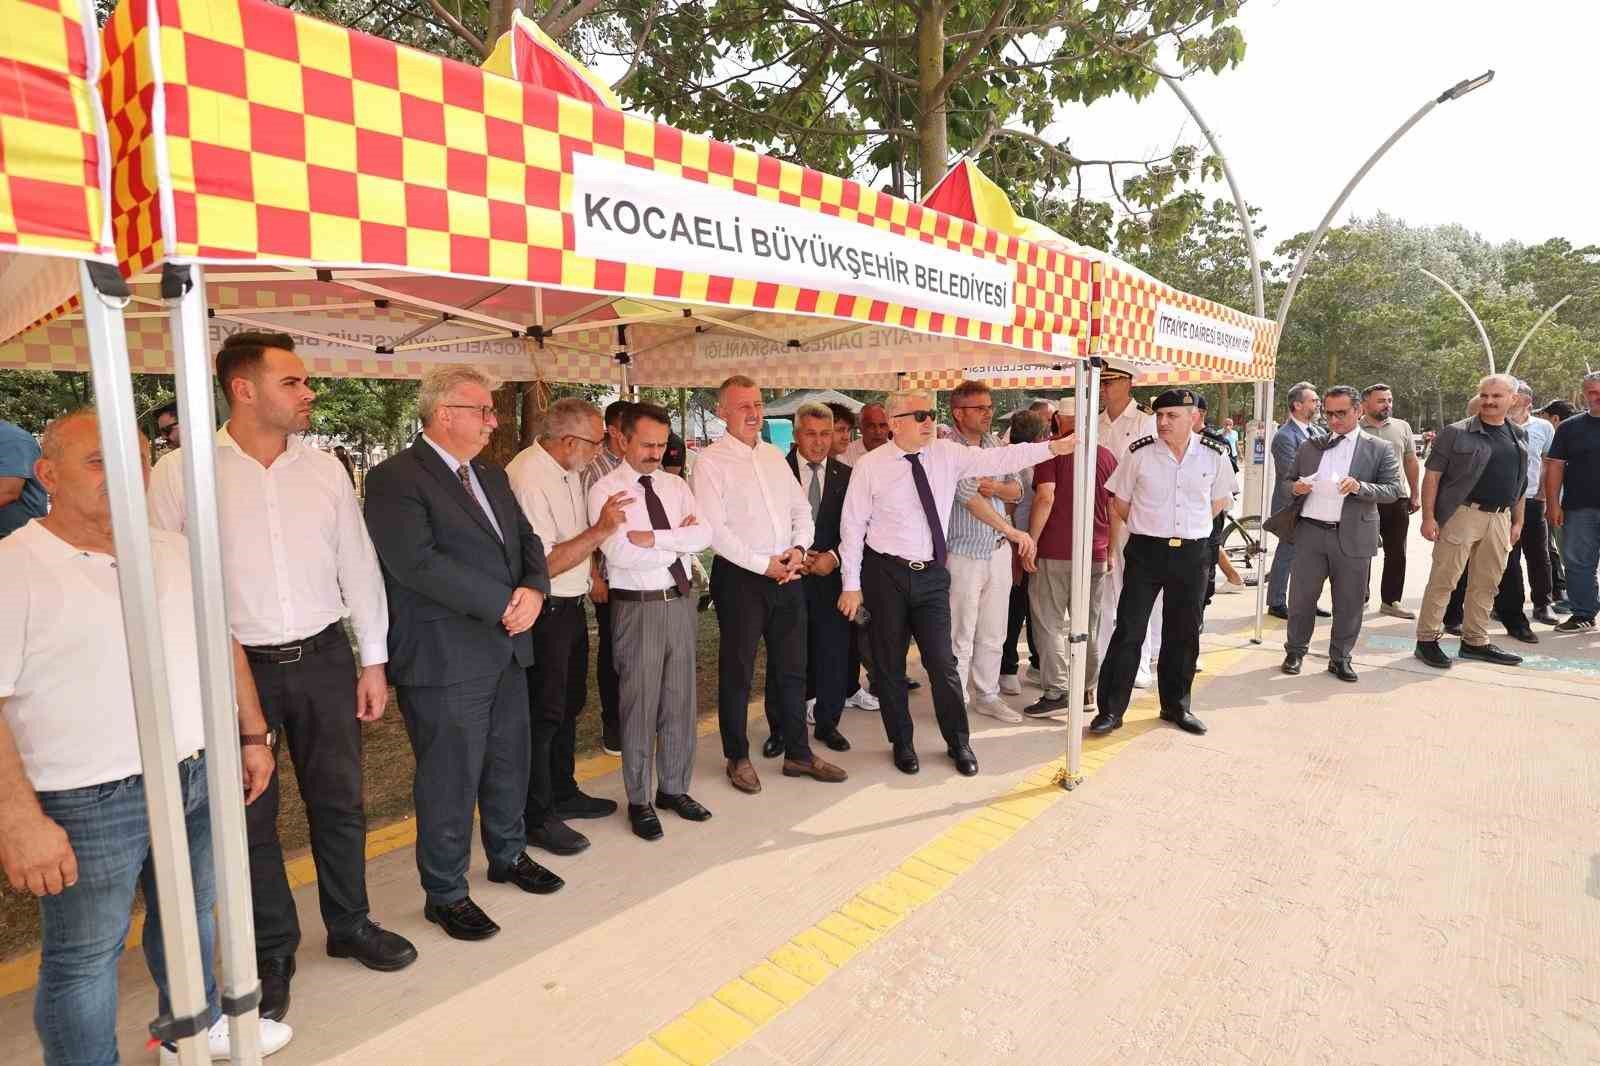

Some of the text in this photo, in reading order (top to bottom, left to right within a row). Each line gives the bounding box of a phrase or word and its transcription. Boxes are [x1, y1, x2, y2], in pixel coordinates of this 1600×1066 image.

[584, 193, 1007, 308] KOCAELİ BÜYÜKŞEHİR BELEDİYESİ
[1159, 312, 1188, 338] İTFAİYE
[1189, 321, 1216, 345] DAİRESİ
